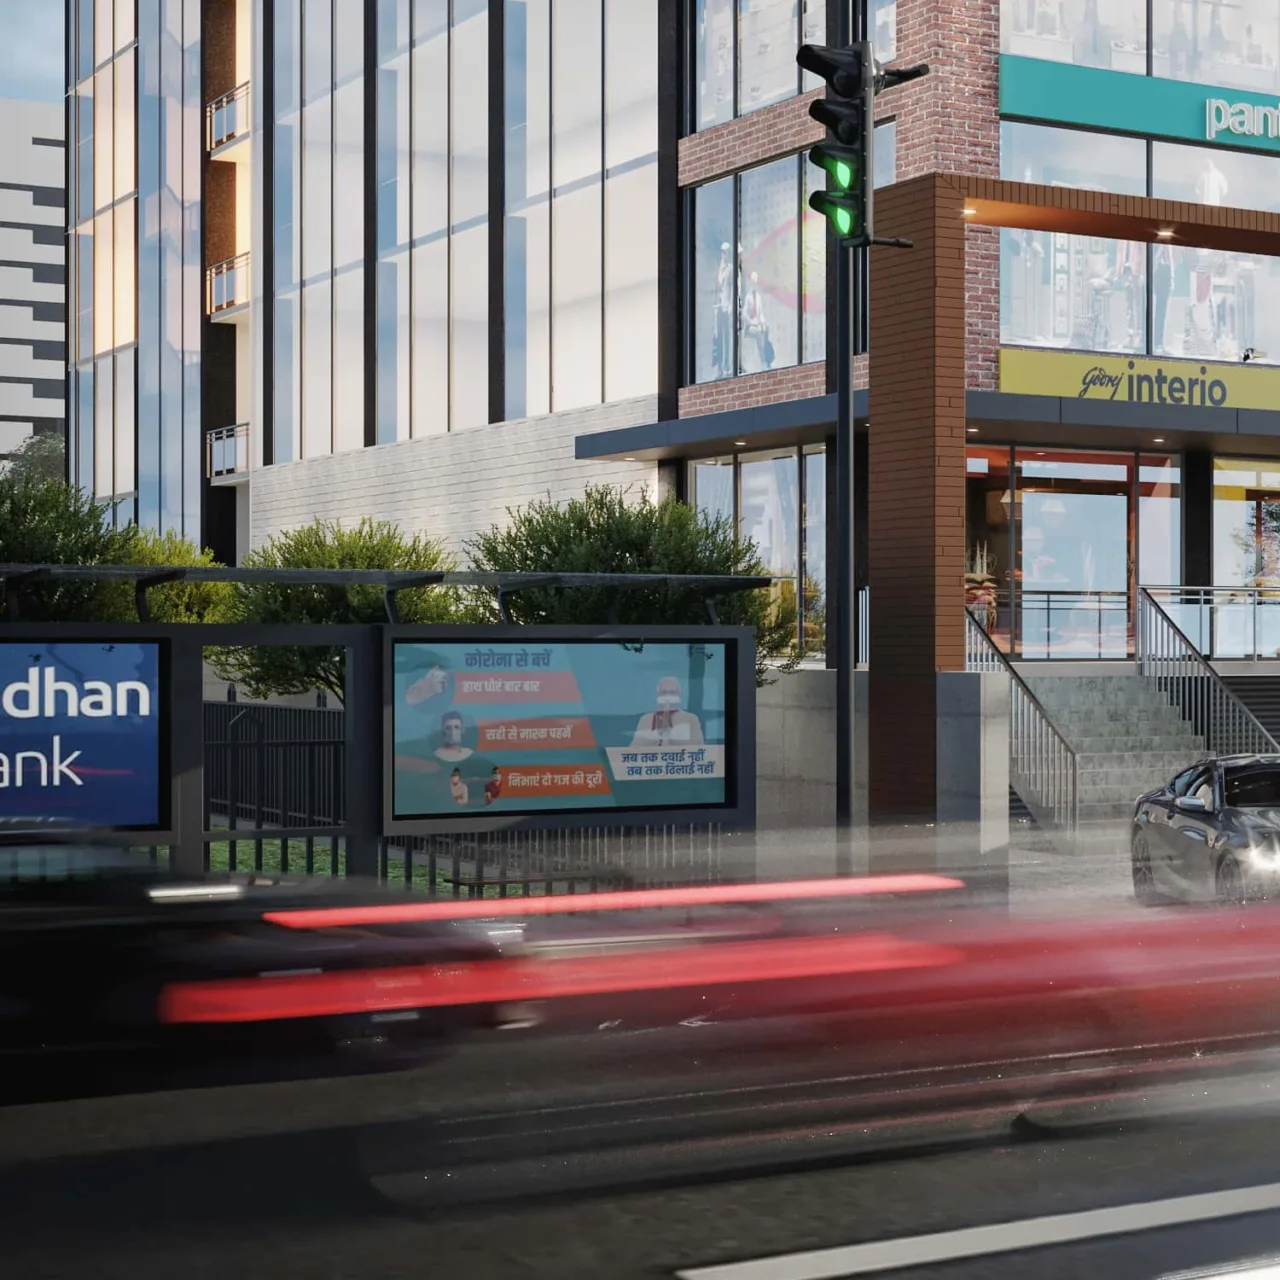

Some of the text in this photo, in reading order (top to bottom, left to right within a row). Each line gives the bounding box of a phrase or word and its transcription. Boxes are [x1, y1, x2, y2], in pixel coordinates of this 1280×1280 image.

[1128, 360, 1227, 407] interio
[465, 648, 554, 668] कोरोना से बचें
[508, 725, 517, 740] से
[621, 752, 638, 763] जब
[640, 752, 658, 763] तक
[661, 749, 686, 762] दवाई
[572, 770, 585, 786] की
[626, 766, 643, 776] तब
[645, 765, 663, 776] तक
